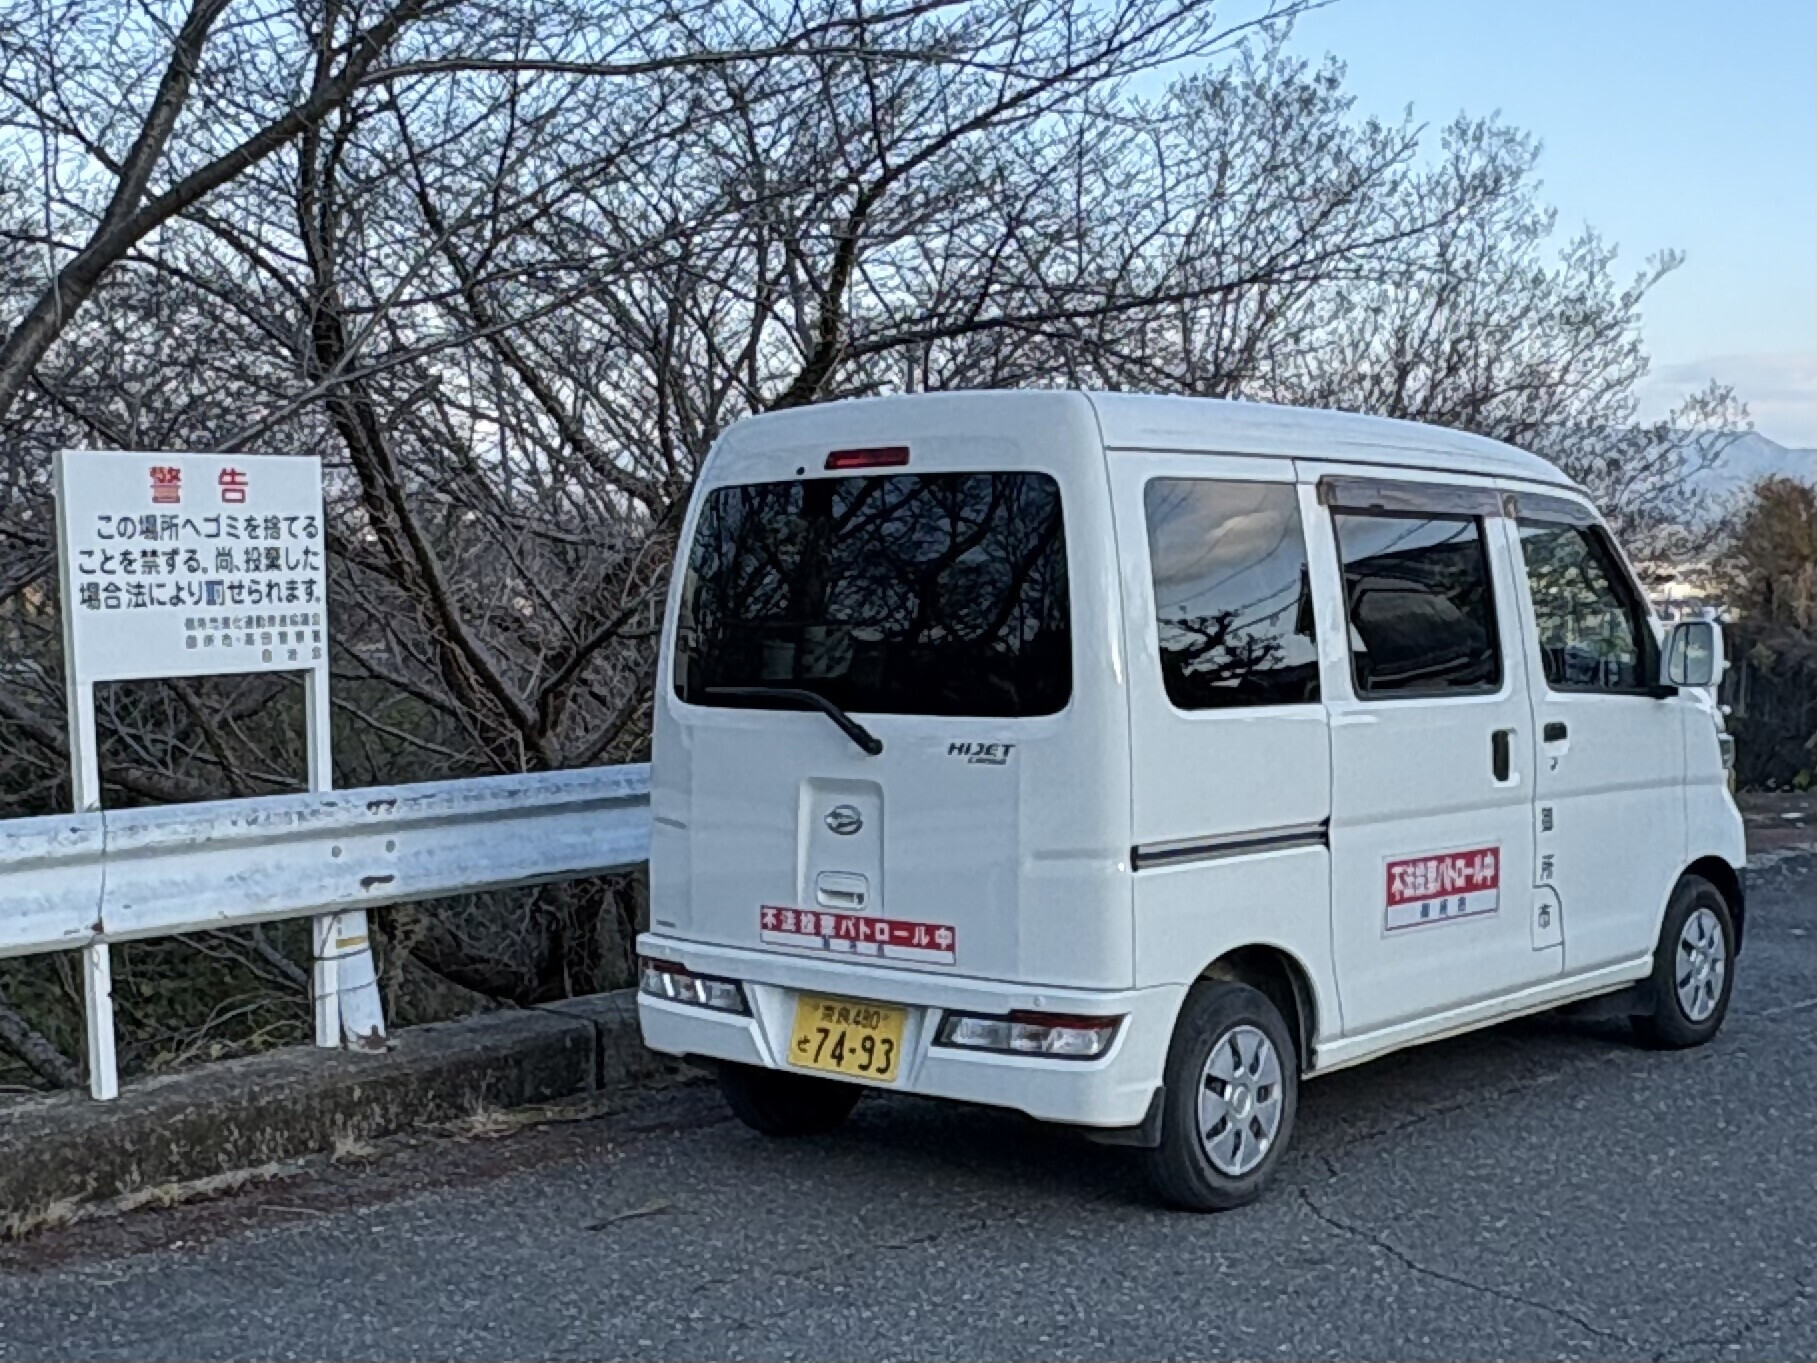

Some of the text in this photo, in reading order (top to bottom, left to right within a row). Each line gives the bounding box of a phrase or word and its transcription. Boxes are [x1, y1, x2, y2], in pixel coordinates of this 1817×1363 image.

[150, 466, 249, 504] 警告
[97, 512, 320, 541] この場所へゴミを捨てる
[947, 742, 1016, 757] HIJET
[813, 1026, 895, 1075] 74-93
